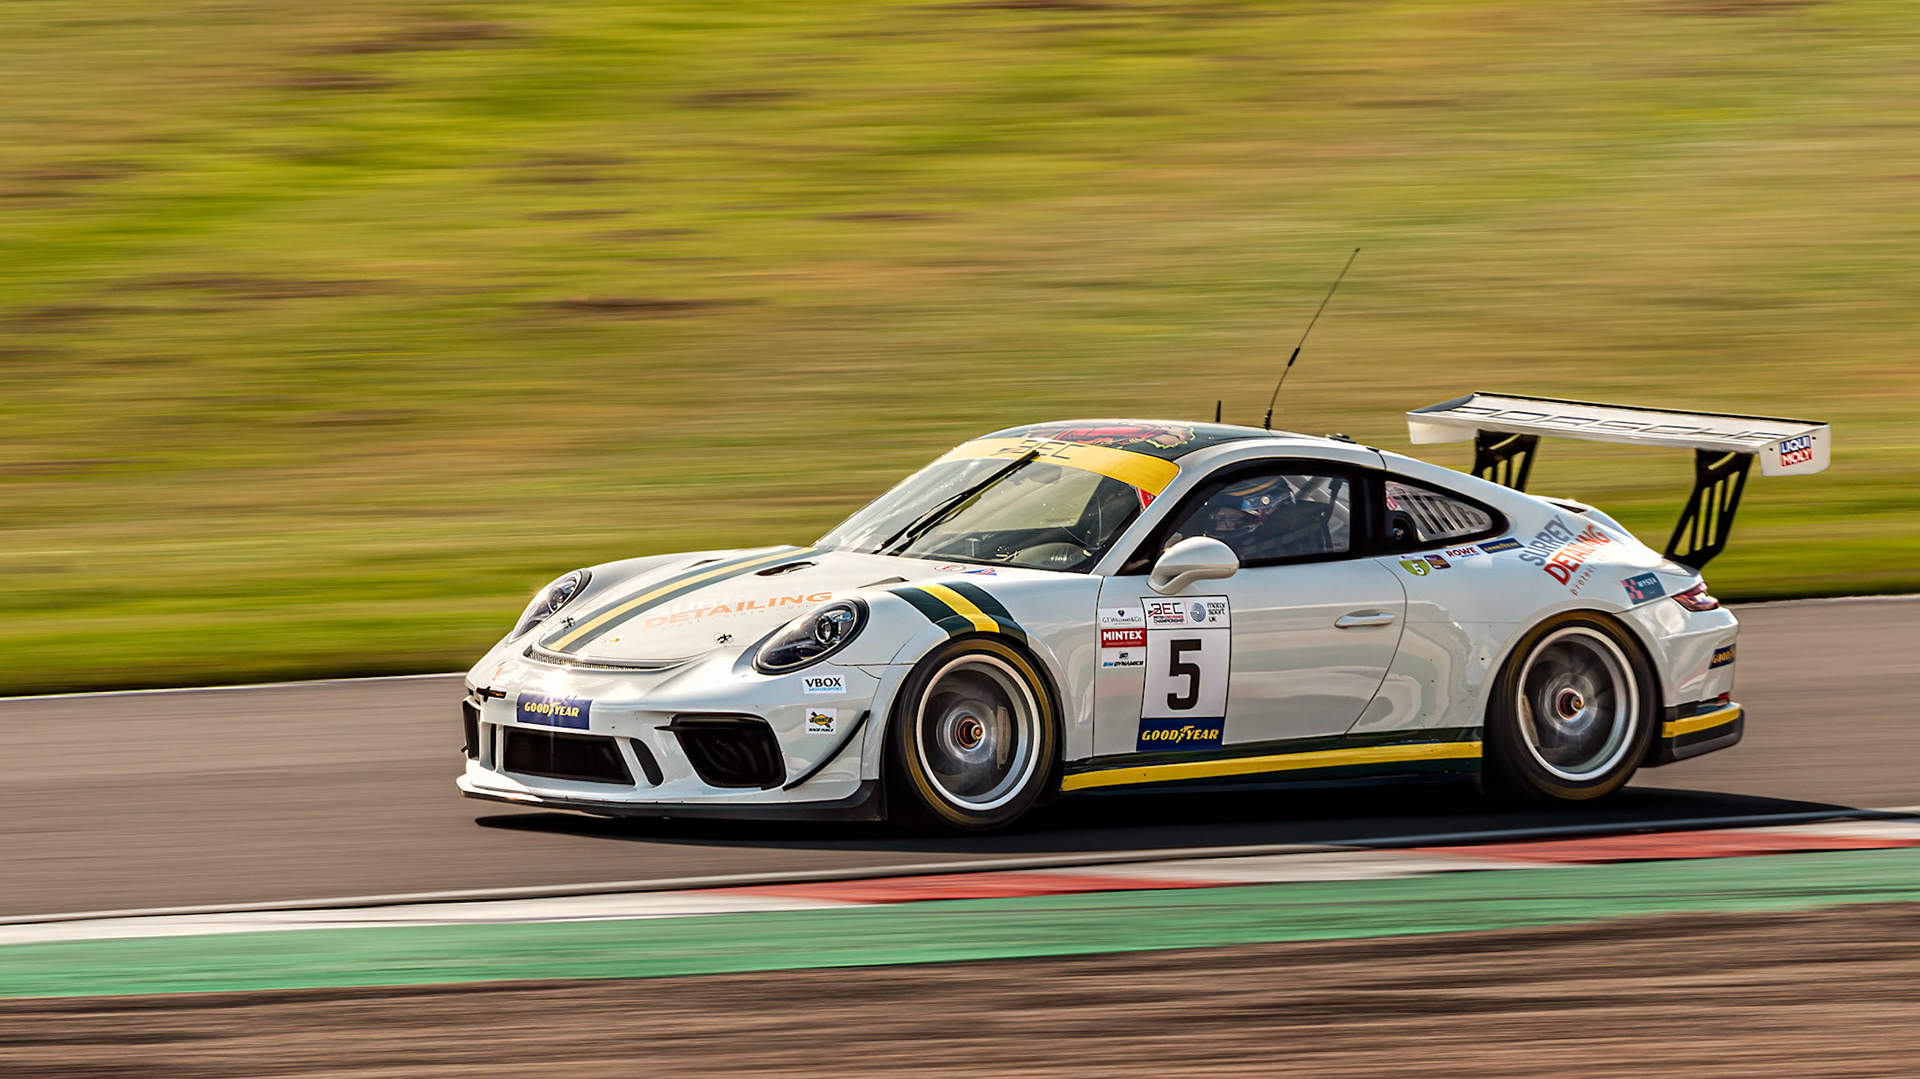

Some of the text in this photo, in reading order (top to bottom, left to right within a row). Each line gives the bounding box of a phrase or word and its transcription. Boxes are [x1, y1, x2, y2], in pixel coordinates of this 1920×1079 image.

[1780, 436, 1812, 453] LIQUI
[1781, 449, 1813, 467] MOLY
[1518, 515, 1575, 566] SURREY
[1445, 547, 1477, 558] ROWE
[1543, 524, 1611, 586] DETAILING
[1412, 563, 1425, 576] 5
[645, 592, 832, 629] DETAILING
[1148, 603, 1184, 617] BEC
[1208, 608, 1226, 616] sport
[1103, 631, 1143, 641] MINTEX
[805, 677, 842, 688] VBOX
[1167, 639, 1202, 711] 5
[524, 701, 580, 717] GOODYEAR
[1142, 725, 1219, 743] GOODYEAR
